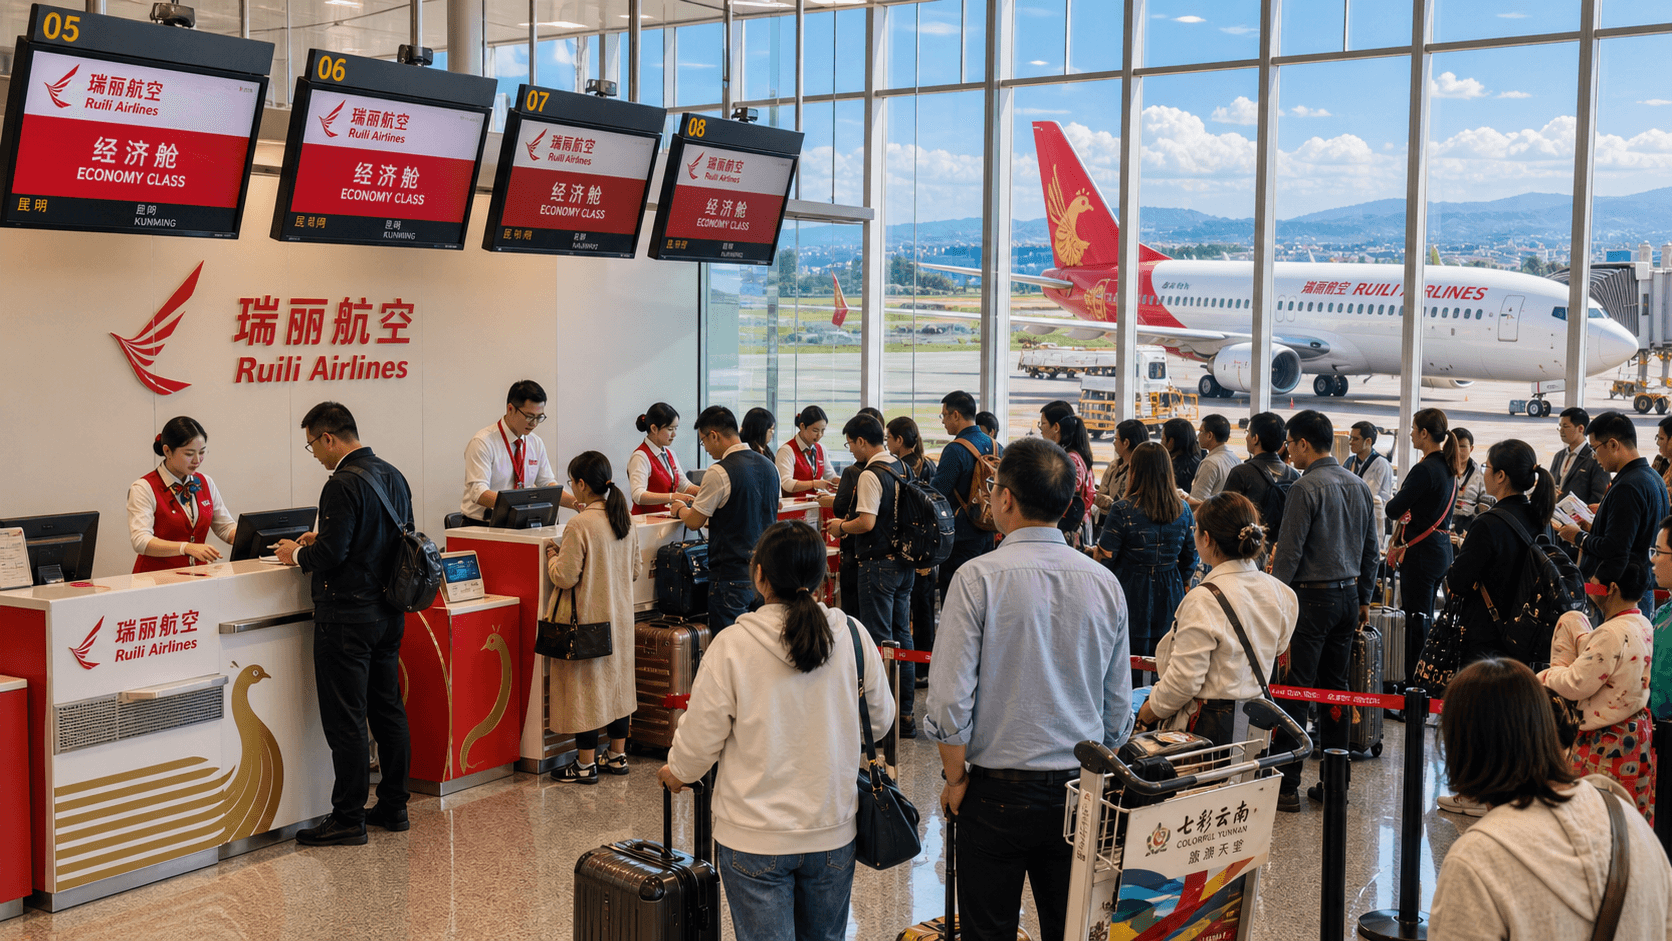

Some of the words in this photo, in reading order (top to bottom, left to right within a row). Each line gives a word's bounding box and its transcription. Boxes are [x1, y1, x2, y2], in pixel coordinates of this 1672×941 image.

[43, 12, 80, 42] 05
[318, 56, 346, 82] 06
[87, 73, 164, 102] 瑞丽航空
[84, 98, 112, 112] Ruili
[114, 102, 158, 116] Airlines
[526, 90, 550, 112] 07
[350, 107, 410, 131] 瑞丽航空
[688, 117, 706, 138] 08
[348, 128, 370, 140] Ruili
[372, 131, 406, 144] Airlines
[92, 136, 179, 169] 经济舱
[76, 167, 144, 184] ECONOMY
[146, 172, 186, 188] CLASS
[353, 162, 420, 189] 经济舱
[340, 188, 392, 203] ECONOMY
[394, 192, 424, 205] CLASS
[550, 181, 602, 205] 经济舱
[134, 217, 176, 228] KUNMING
[540, 204, 580, 217] ECONOMY
[580, 208, 606, 220] CLASS
[696, 218, 730, 230] ECONOMY
[730, 220, 750, 231] CLASS
[1352, 282, 1400, 296] RUILI
[231, 295, 414, 346] 瑞丽航空
[234, 355, 302, 384] Ruili
[309, 354, 408, 381] Airlines
[114, 610, 200, 644] 瑞丽航空
[115, 644, 145, 662] Ruili
[148, 638, 198, 656] Airlines
[1176, 800, 1250, 834] 七彩云南
[1218, 826, 1248, 838] YUNNAN
